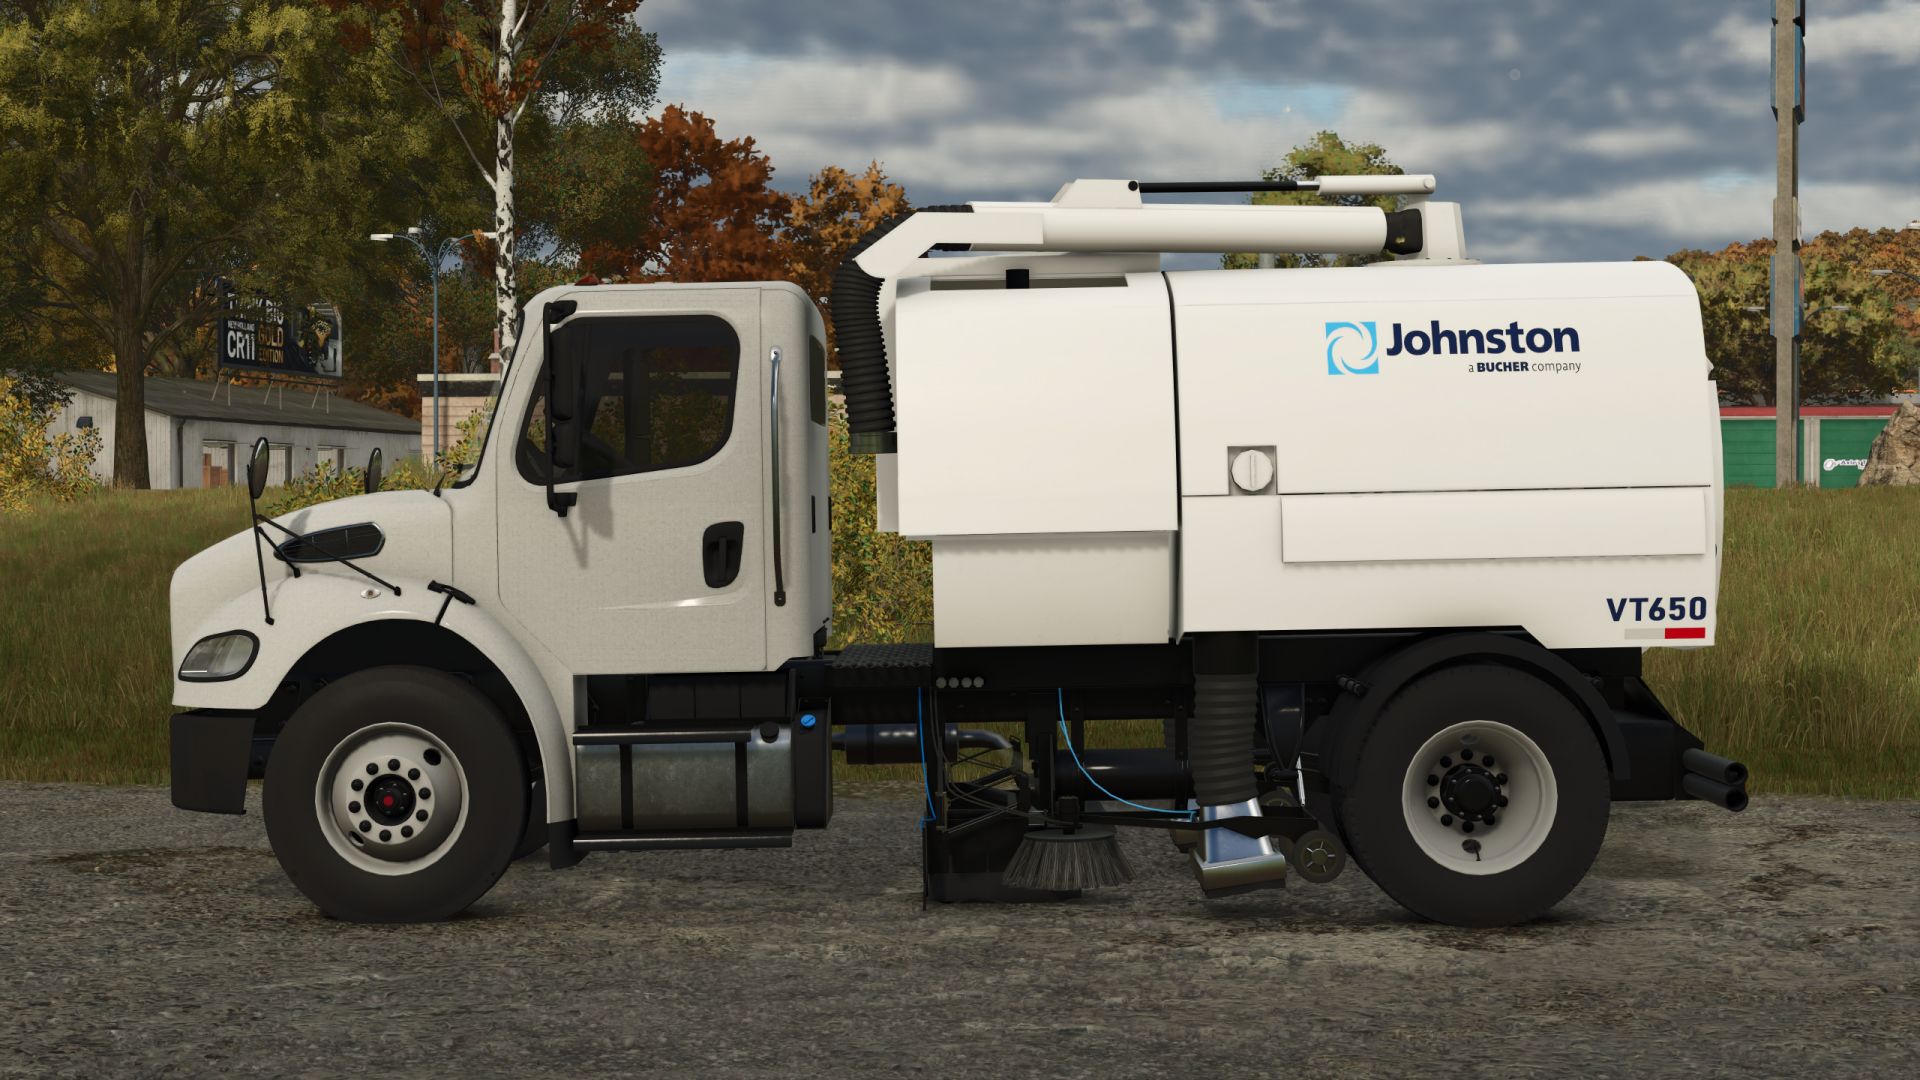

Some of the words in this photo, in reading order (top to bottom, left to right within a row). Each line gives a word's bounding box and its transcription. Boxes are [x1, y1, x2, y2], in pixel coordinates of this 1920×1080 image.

[227, 330, 255, 360] CR11
[1386, 320, 1580, 356] Johnston
[1468, 363, 1474, 373] a
[1477, 361, 1529, 373] BUCHER
[1531, 361, 1581, 374] company
[1606, 596, 1707, 622] VT650
